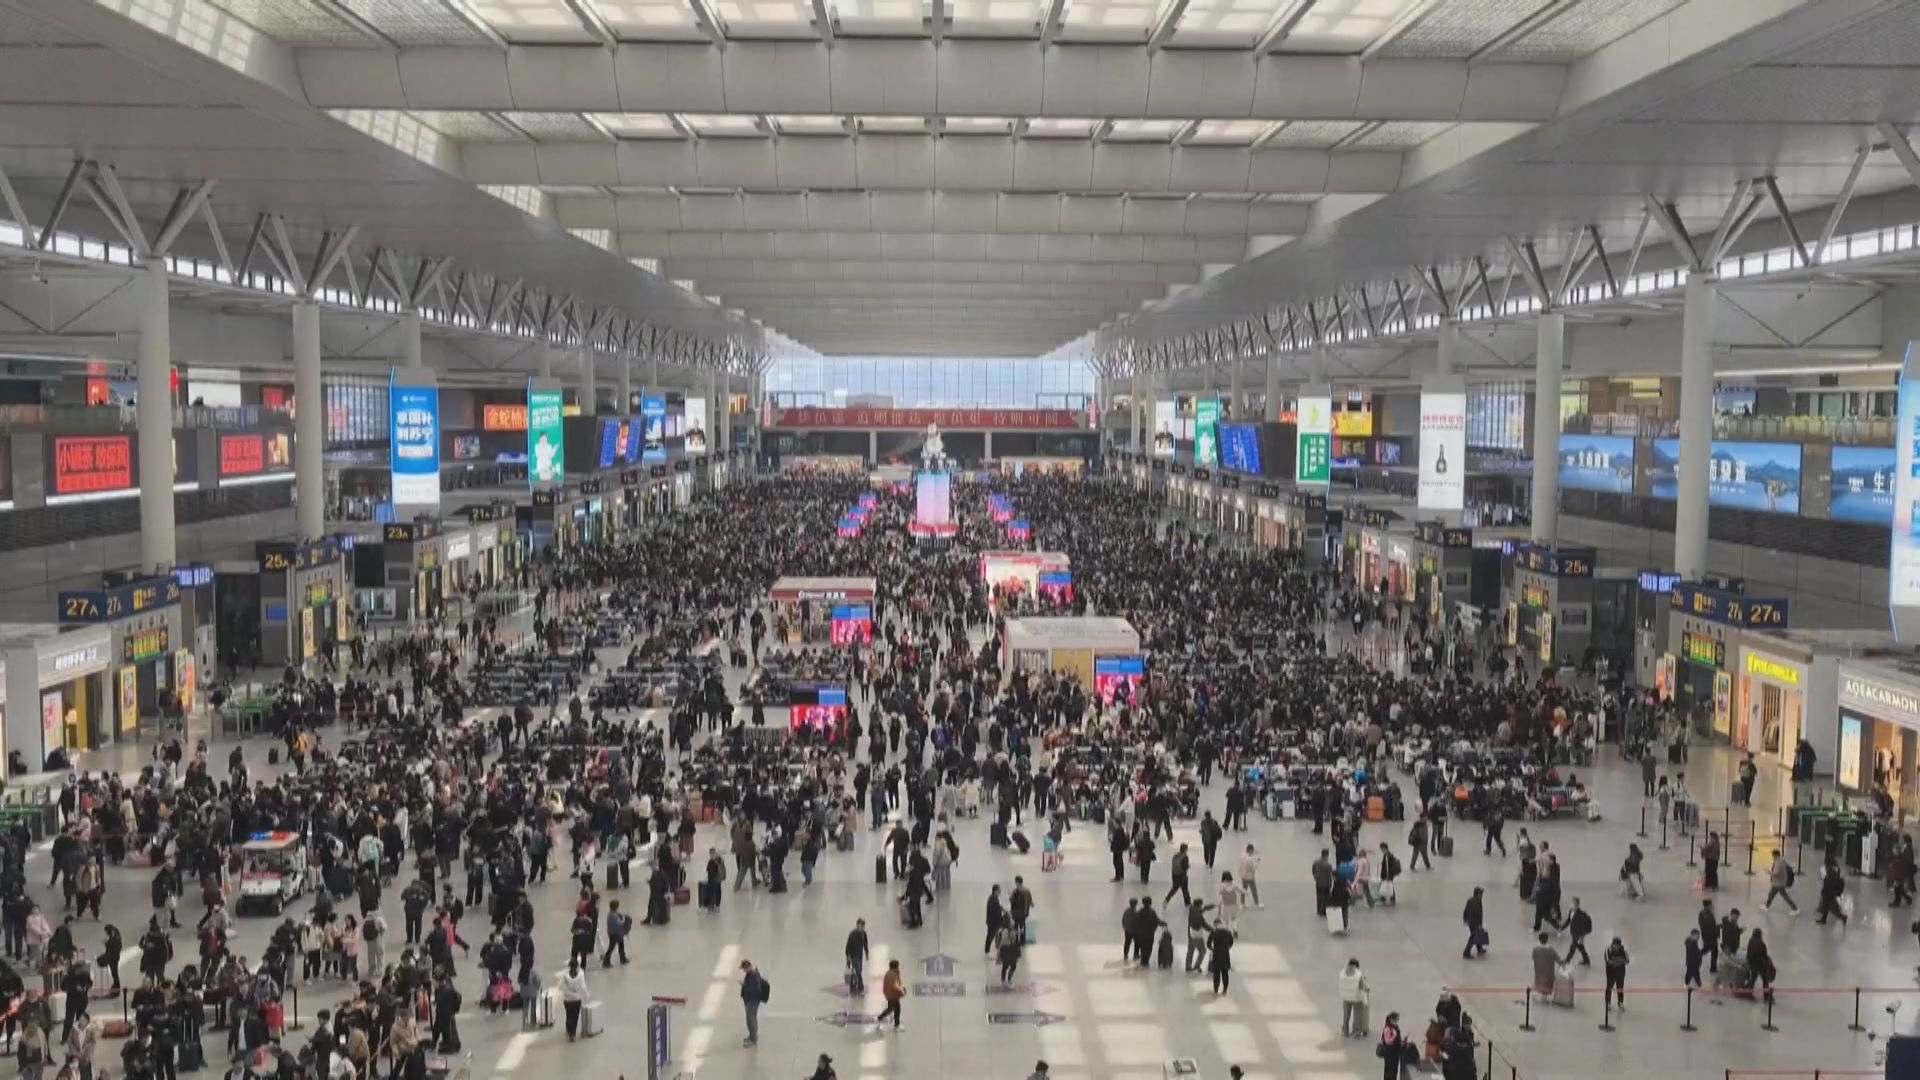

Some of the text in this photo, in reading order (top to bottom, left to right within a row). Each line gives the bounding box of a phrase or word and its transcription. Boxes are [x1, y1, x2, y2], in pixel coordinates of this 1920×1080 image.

[387, 528, 408, 541] 23A
[265, 554, 289, 569] 25A
[66, 598, 98, 617] 27A
[106, 596, 122, 616] 27A
[1750, 604, 1781, 624] 27B
